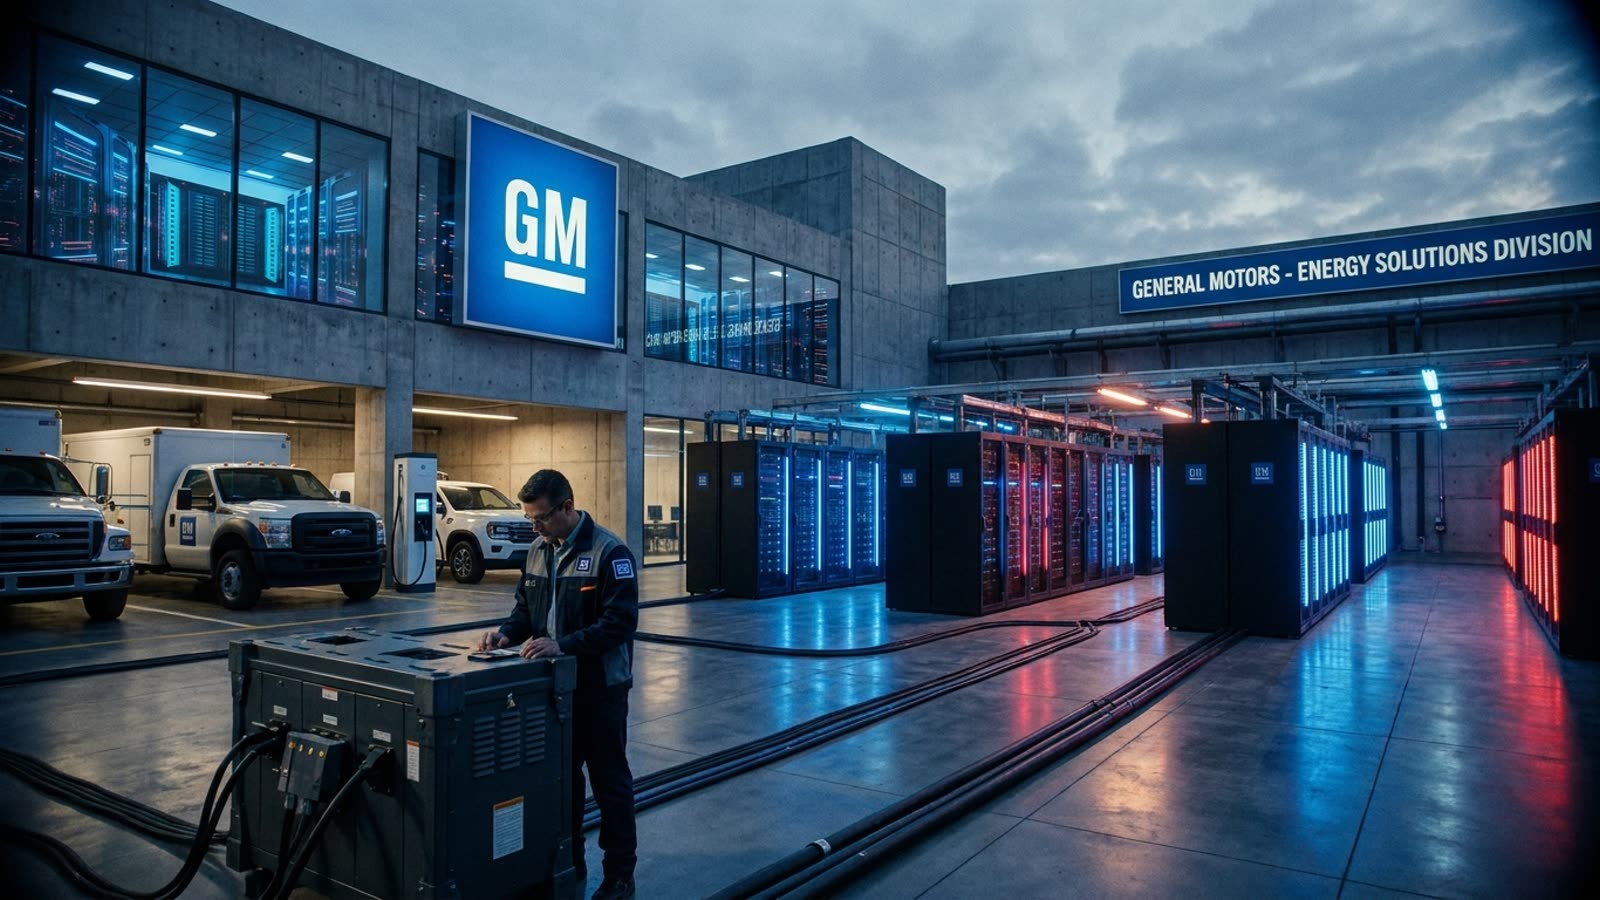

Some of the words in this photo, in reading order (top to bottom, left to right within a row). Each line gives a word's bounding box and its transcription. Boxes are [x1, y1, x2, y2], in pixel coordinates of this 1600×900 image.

[505, 179, 587, 269] GM
[1132, 274, 1205, 299] GENERAL
[1209, 265, 1280, 291] MOTORS
[1298, 254, 1370, 281] ENERGY
[1375, 241, 1488, 273] SOLUTIONS
[1494, 228, 1592, 261] DIVISION
